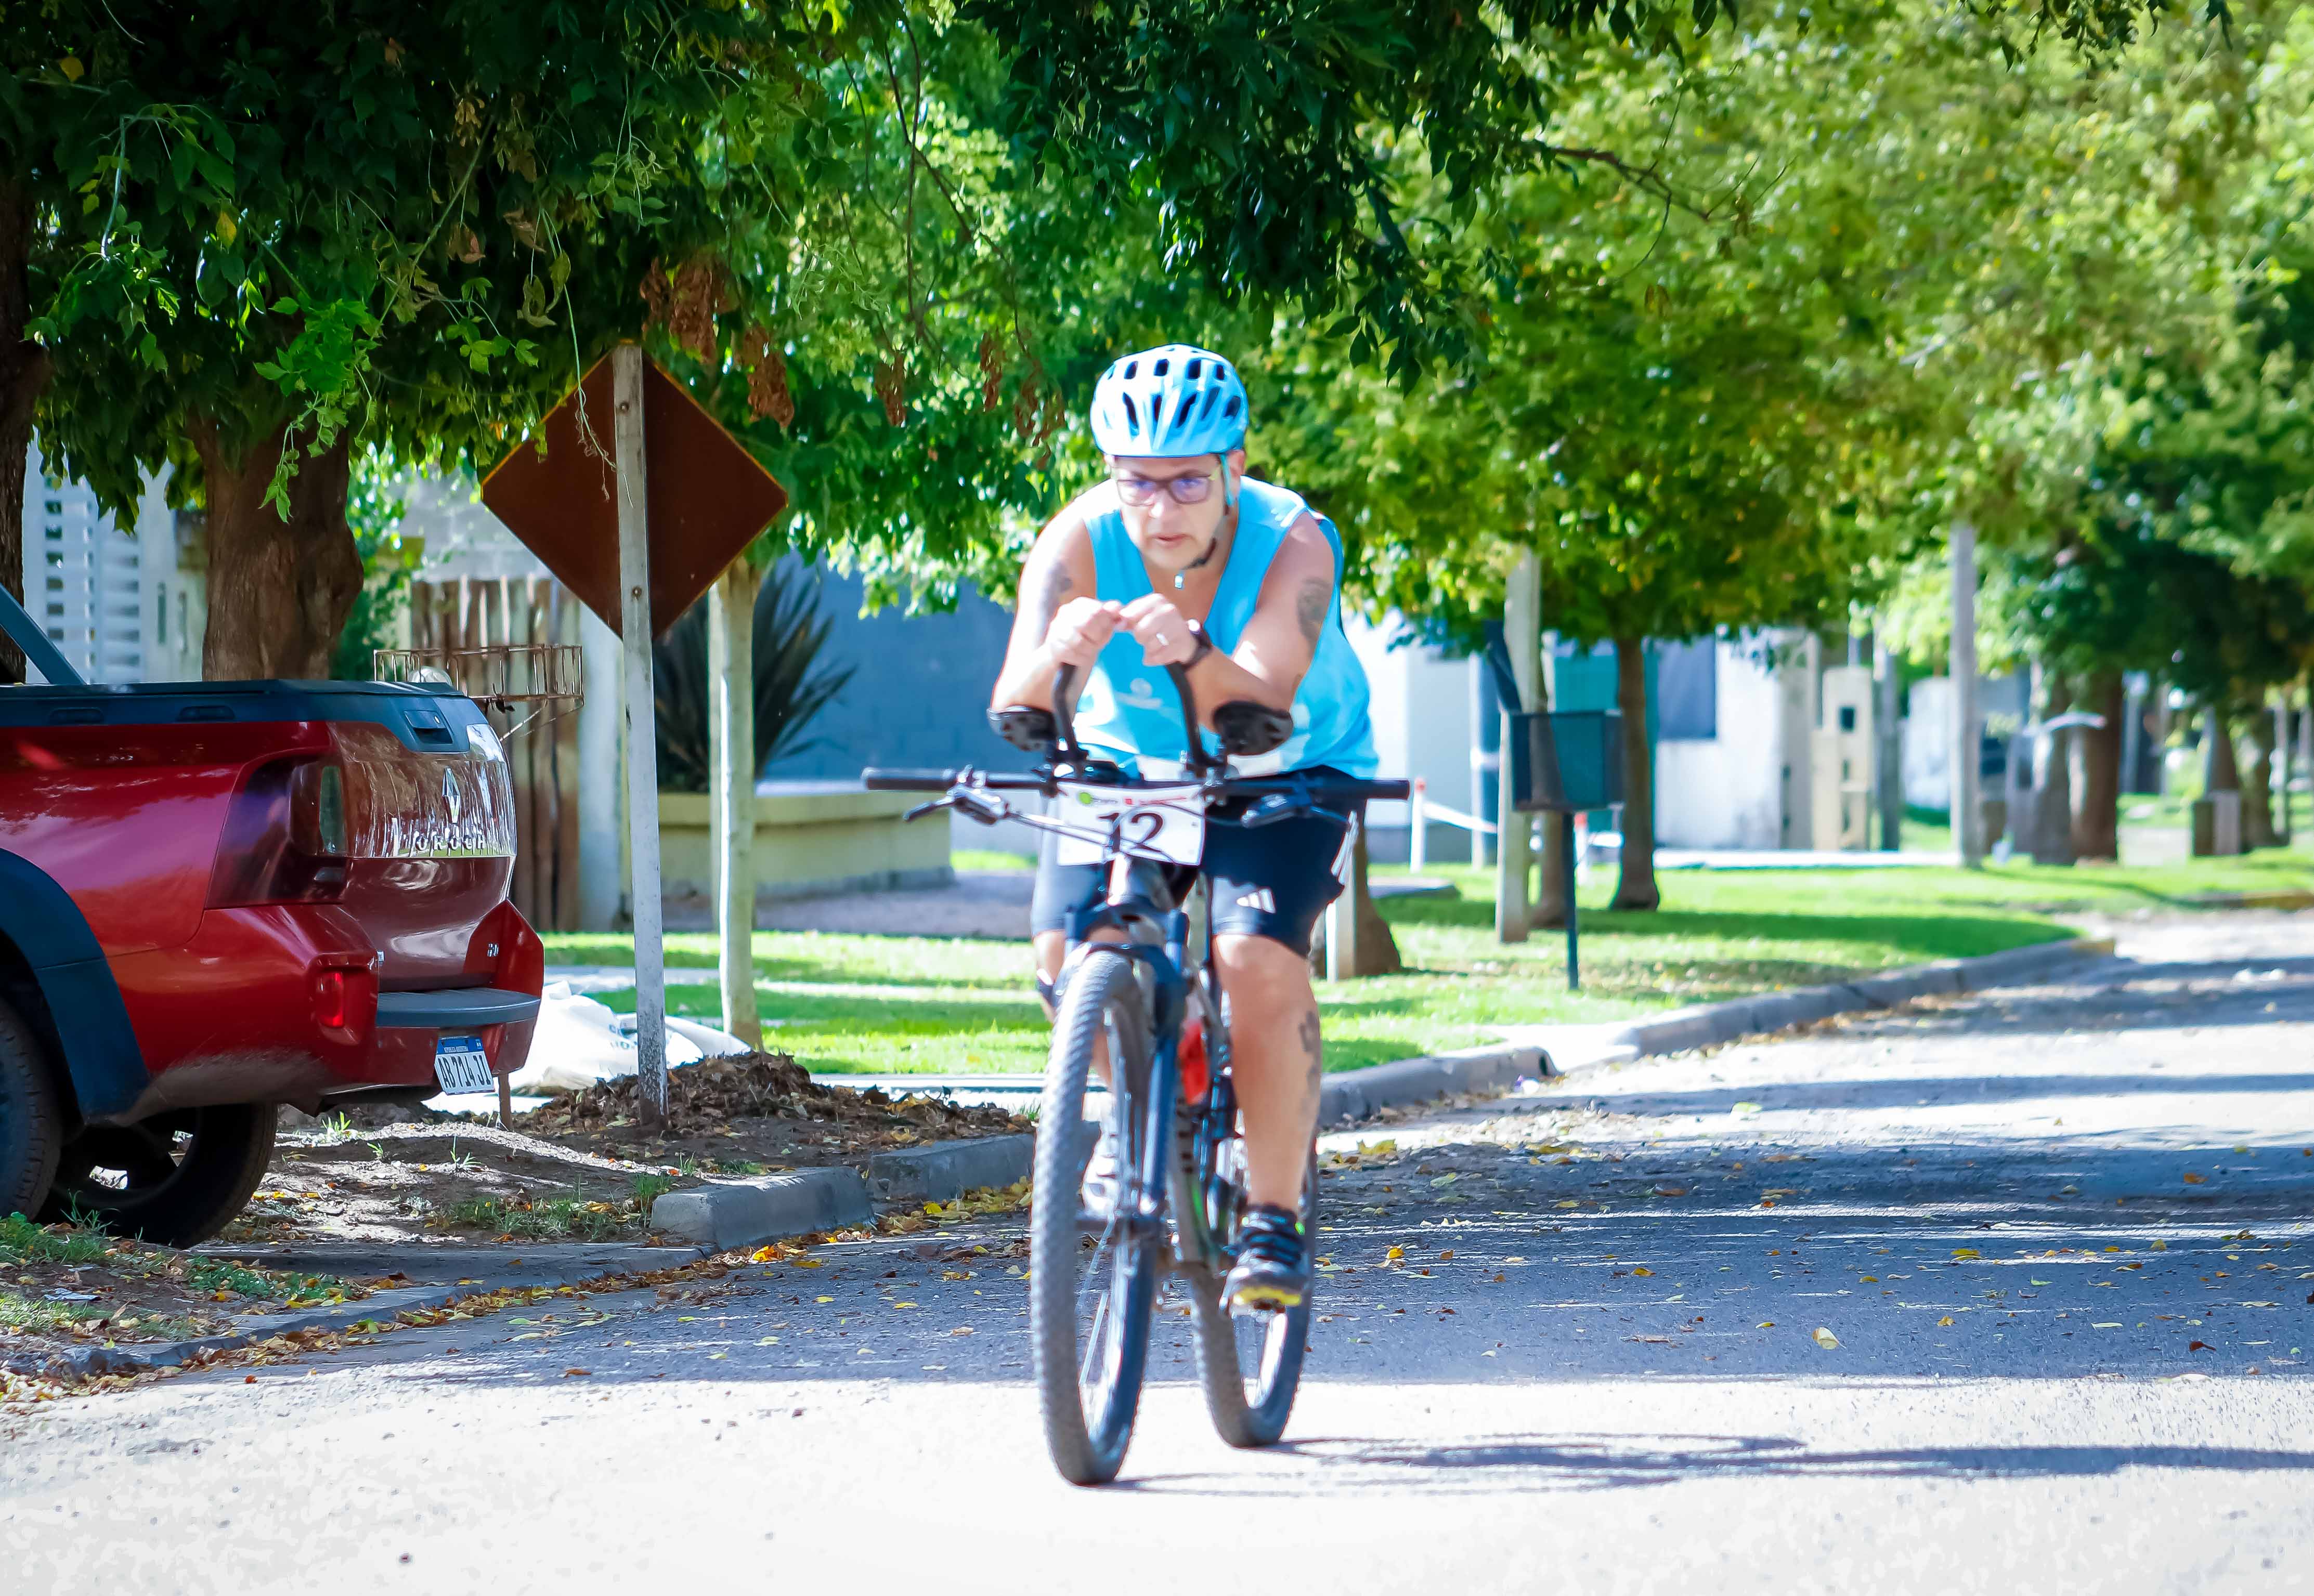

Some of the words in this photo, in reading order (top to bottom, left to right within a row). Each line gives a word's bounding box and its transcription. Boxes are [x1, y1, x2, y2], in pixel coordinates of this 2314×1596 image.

[1096, 812, 1163, 853] 12
[437, 1057, 456, 1089] AB
[473, 1055, 491, 1085] JI
